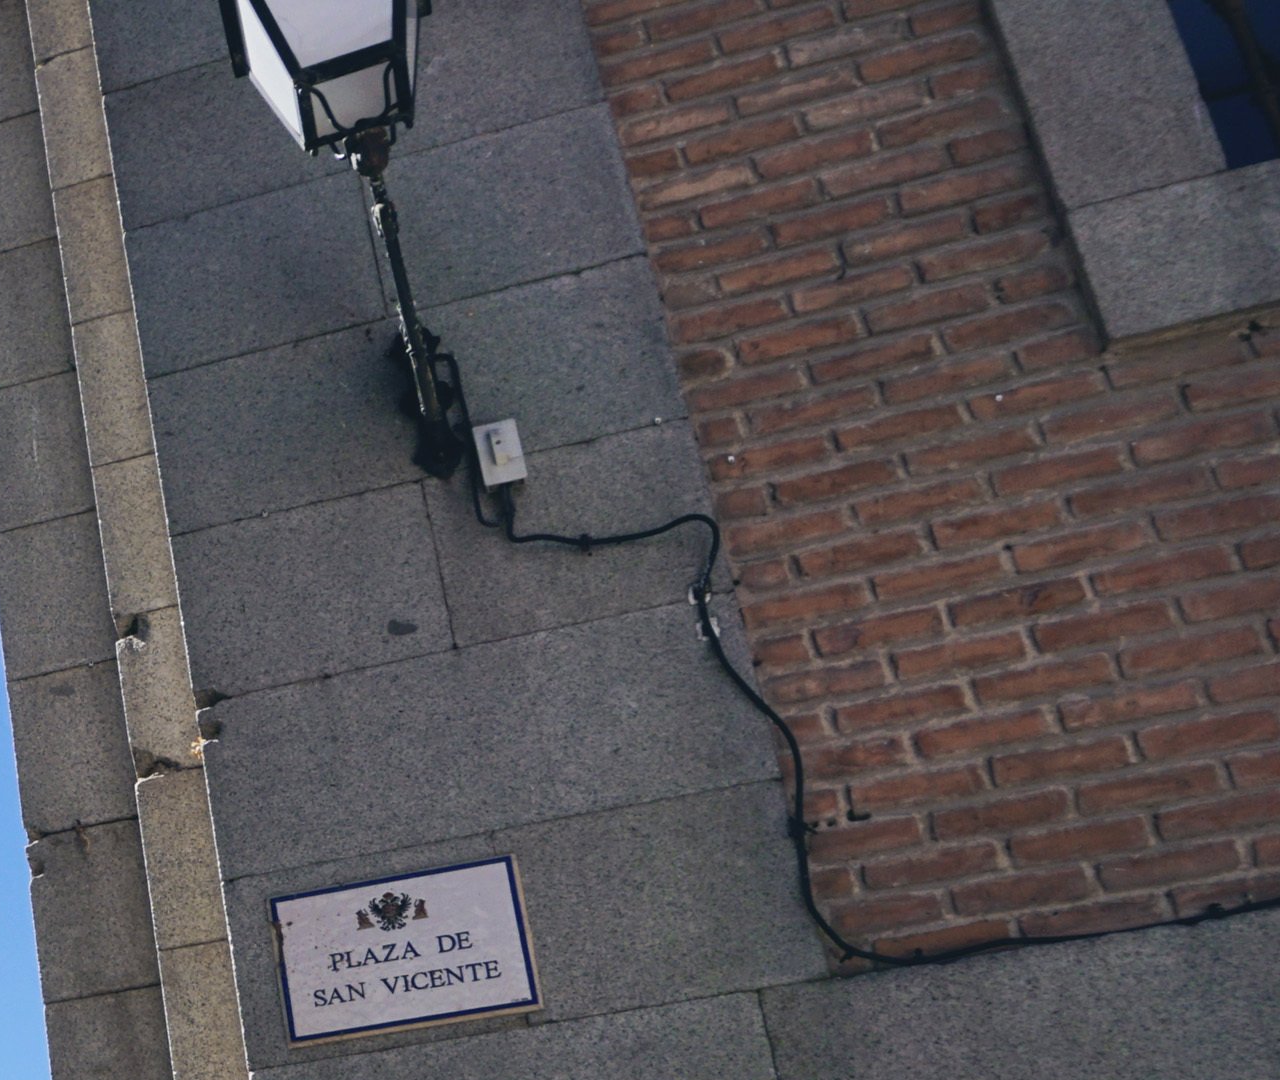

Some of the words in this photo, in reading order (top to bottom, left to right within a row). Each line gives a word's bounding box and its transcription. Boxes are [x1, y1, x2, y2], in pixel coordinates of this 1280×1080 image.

[328, 940, 421, 972] PLAZA
[436, 931, 474, 954] DE
[313, 981, 366, 1008] SAN
[380, 960, 503, 994] VICENTE
